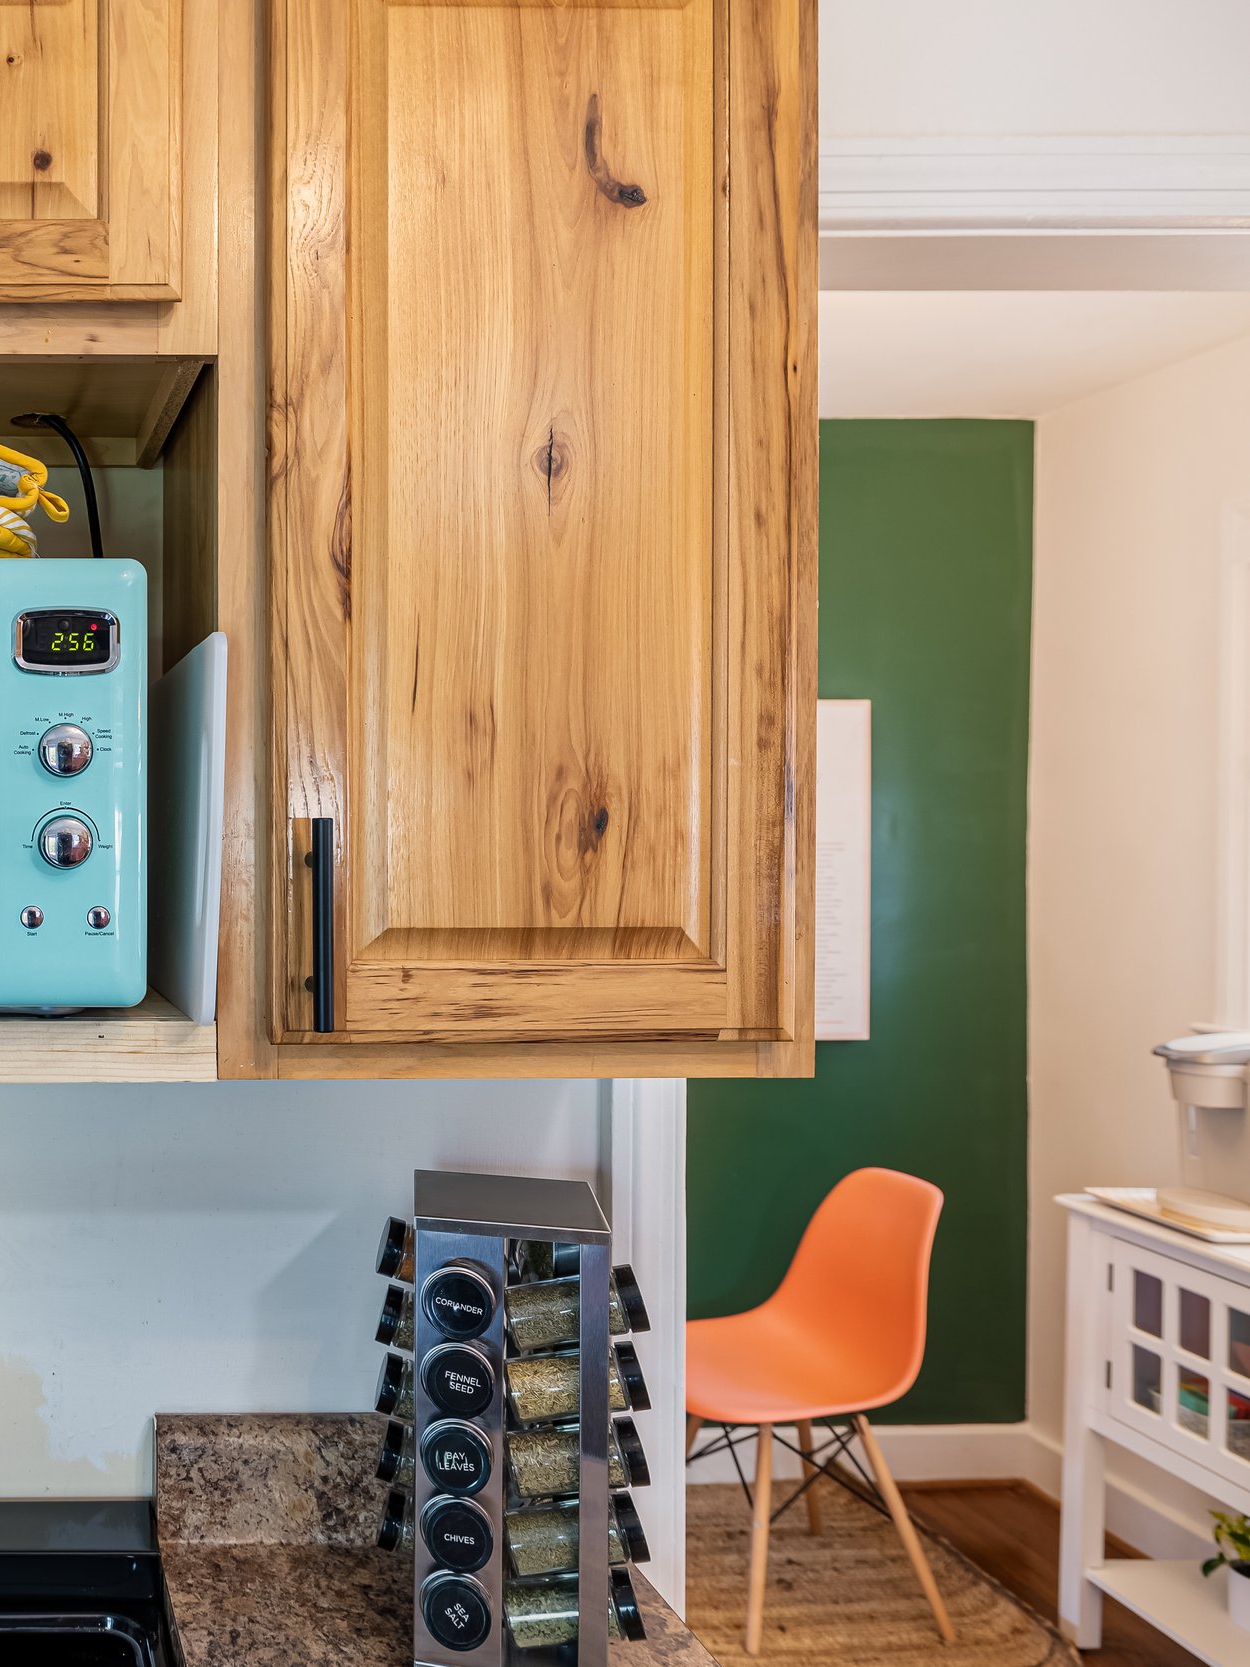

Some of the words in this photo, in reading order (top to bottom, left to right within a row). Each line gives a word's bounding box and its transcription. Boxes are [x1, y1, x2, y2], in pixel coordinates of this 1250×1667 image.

[435, 1296, 484, 1316] CORIANDER
[445, 1370, 481, 1387] FENNEL
[449, 1381, 475, 1394] SEED
[445, 1451, 466, 1460] BAY
[439, 1462, 476, 1472] LEAVES
[443, 1533, 475, 1545] CHIVES
[444, 1607, 466, 1629] SALT
[453, 1602, 469, 1623] SEA
